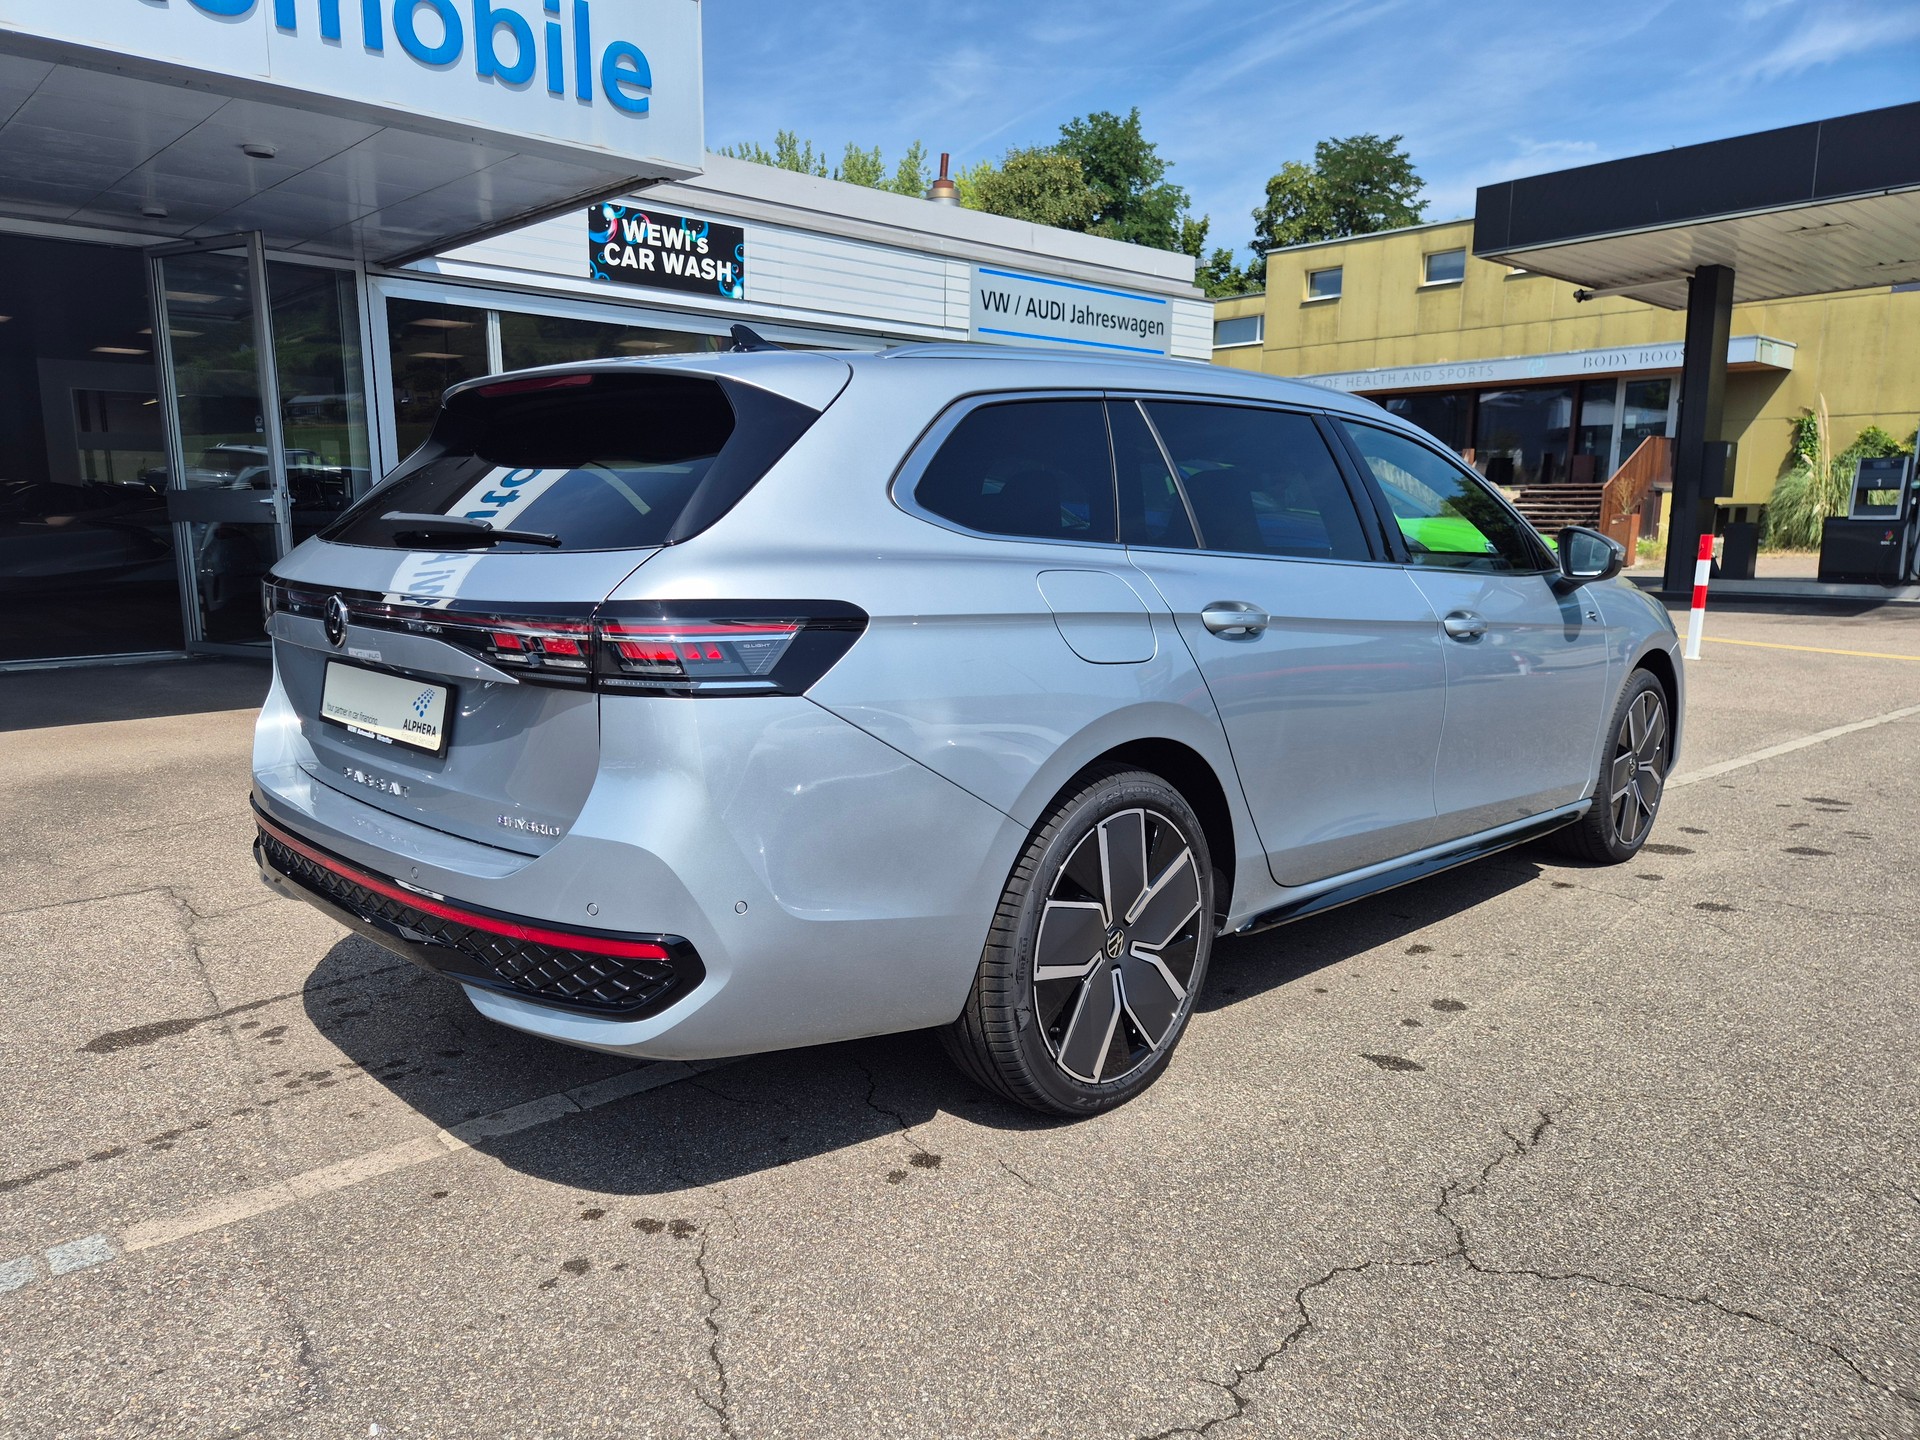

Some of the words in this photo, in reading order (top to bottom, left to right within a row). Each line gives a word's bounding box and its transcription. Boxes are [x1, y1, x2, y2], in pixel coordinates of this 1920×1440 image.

[140, 0, 652, 113] mobile
[622, 218, 709, 255] WEWi's
[604, 242, 655, 272] CAR
[661, 251, 732, 282] WASH
[981, 289, 1010, 313] VW
[1014, 295, 1022, 315] /
[1025, 297, 1065, 321] AUDI
[1070, 304, 1164, 338] Jahreswagen
[1323, 377, 1340, 388] OF
[1346, 372, 1396, 387] HEALTH
[1403, 369, 1432, 381] AND
[1438, 364, 1495, 379] SPORTS
[1583, 353, 1632, 368] BODY
[403, 718, 436, 737] ALPHERA
